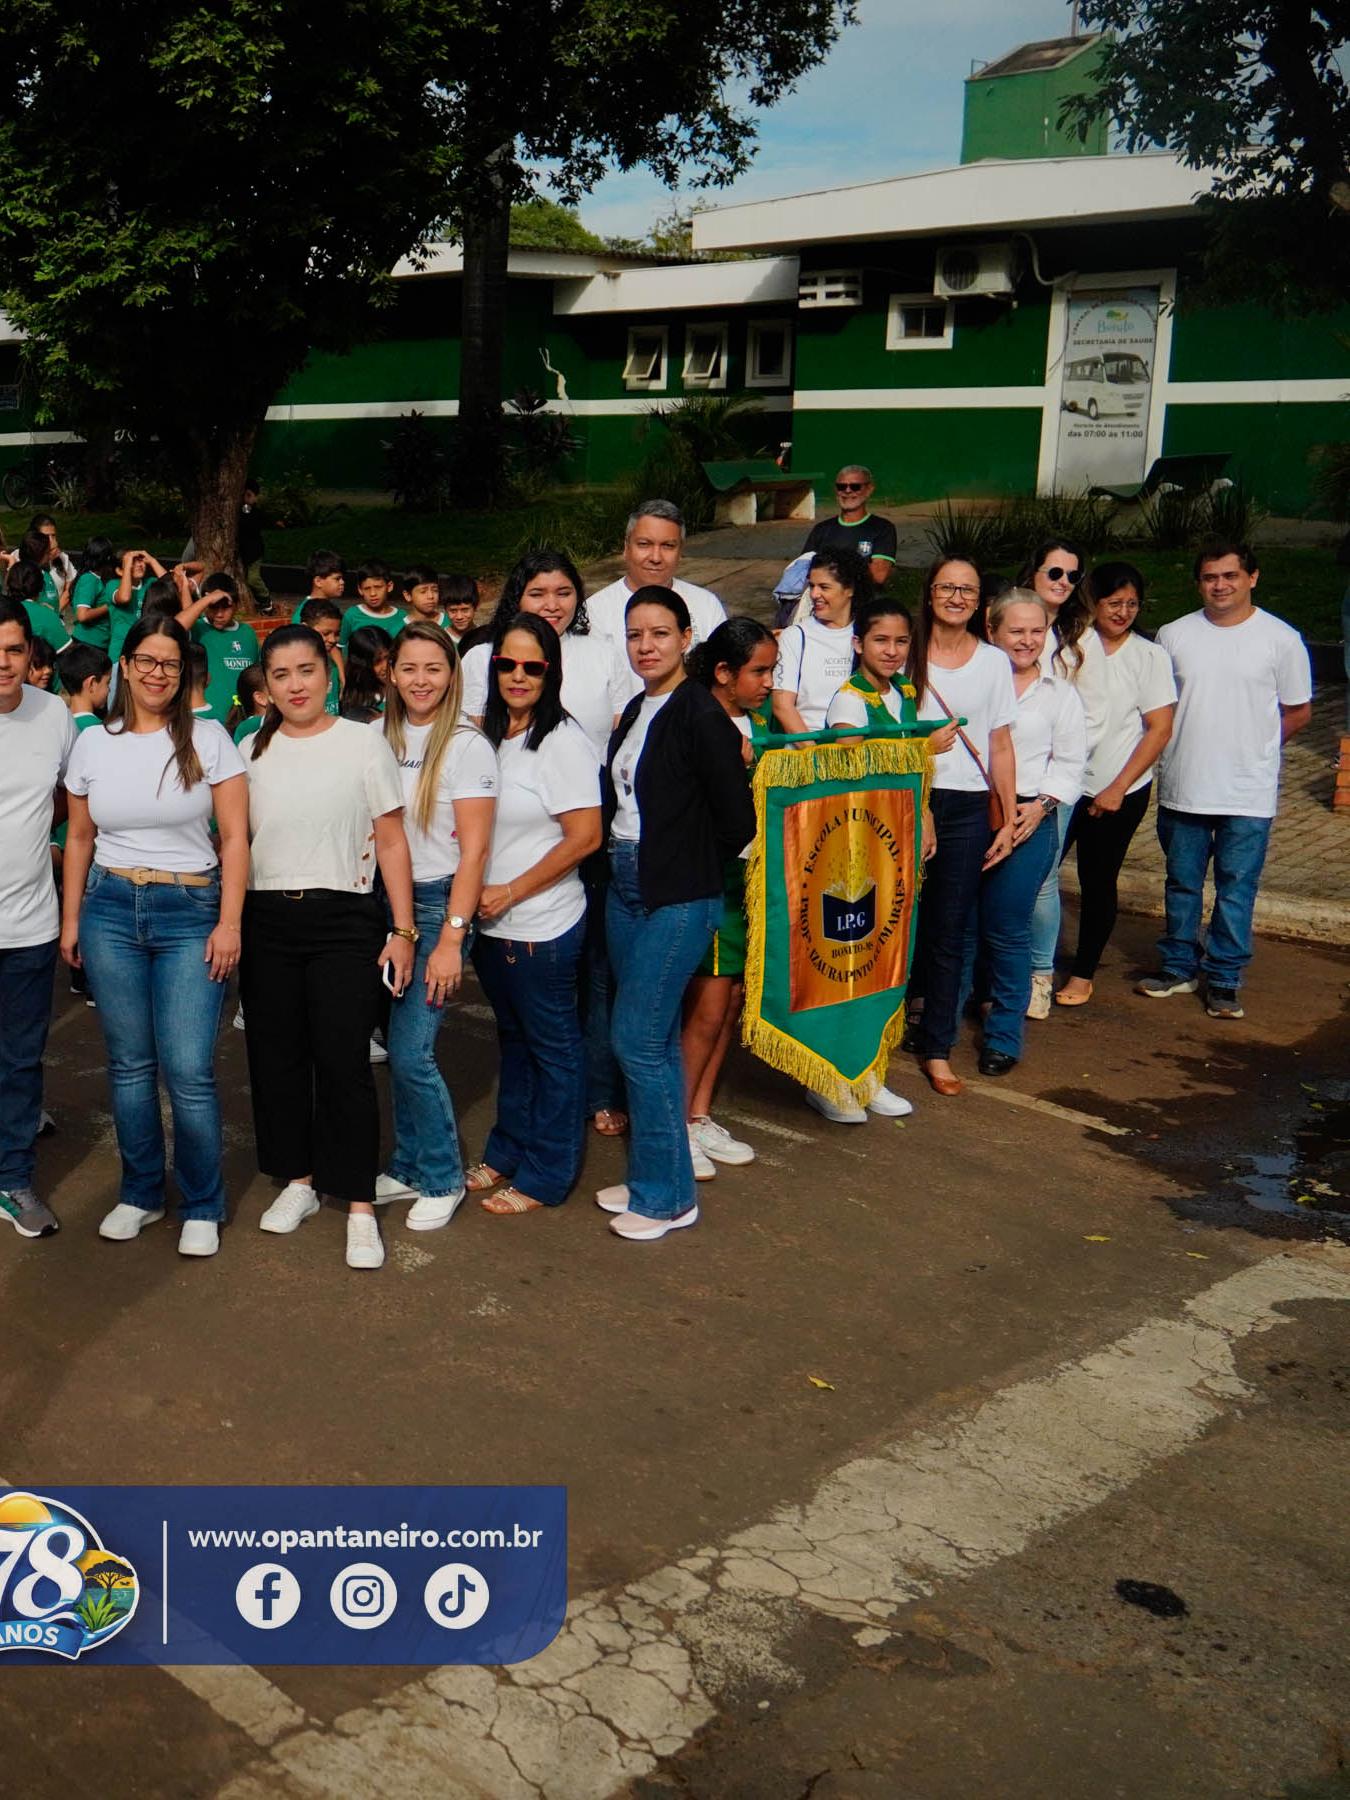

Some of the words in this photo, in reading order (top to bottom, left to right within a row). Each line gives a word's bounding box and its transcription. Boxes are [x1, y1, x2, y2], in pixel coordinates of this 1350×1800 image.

[1067, 430, 1082, 438] das
[1083, 430, 1107, 438] 07:00
[1121, 430, 1144, 438] 11:00
[804, 815, 842, 875] ESCOLA
[844, 959, 874, 984] PINTO
